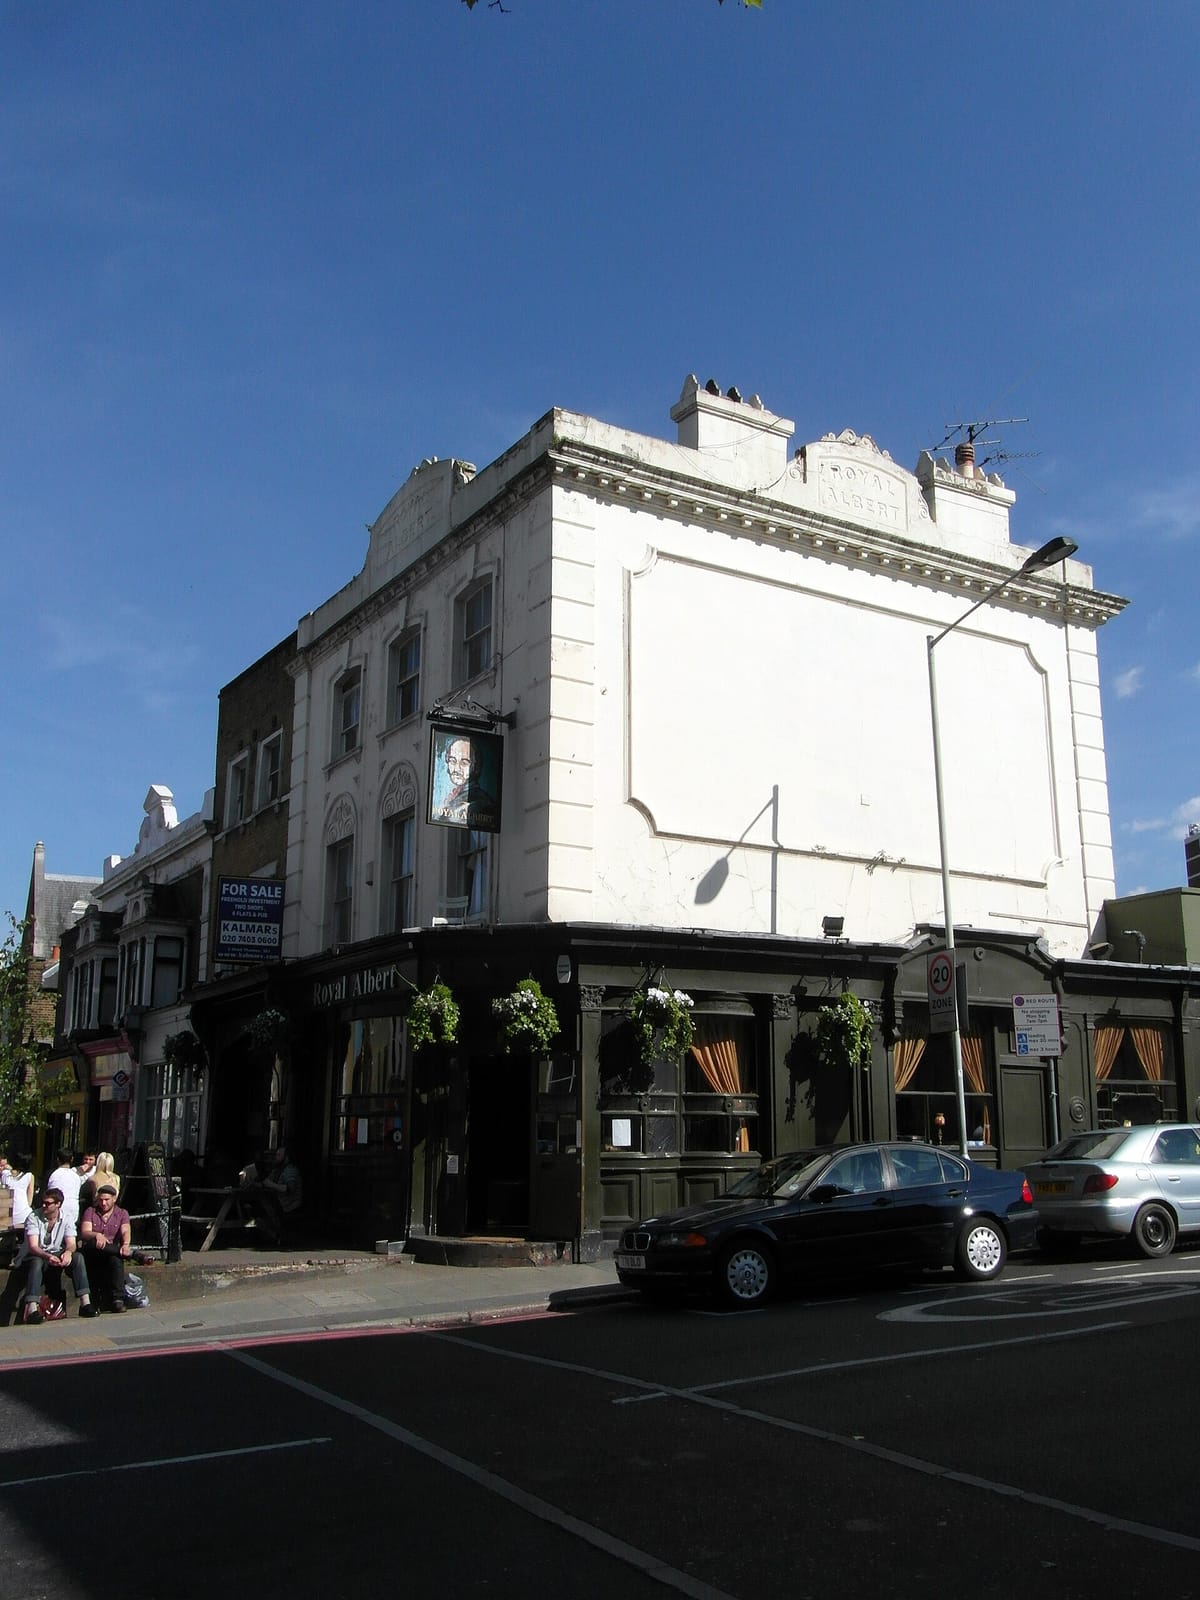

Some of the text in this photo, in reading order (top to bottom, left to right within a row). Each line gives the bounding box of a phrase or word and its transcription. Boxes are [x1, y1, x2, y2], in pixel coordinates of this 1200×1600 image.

[831, 464, 896, 496] ROYAL
[822, 487, 900, 521] ALBERT
[222, 883, 282, 898] FOR SALE
[313, 964, 395, 1007] Royal Albert
[933, 966, 949, 984] 20
[931, 996, 953, 1010] ZONE
